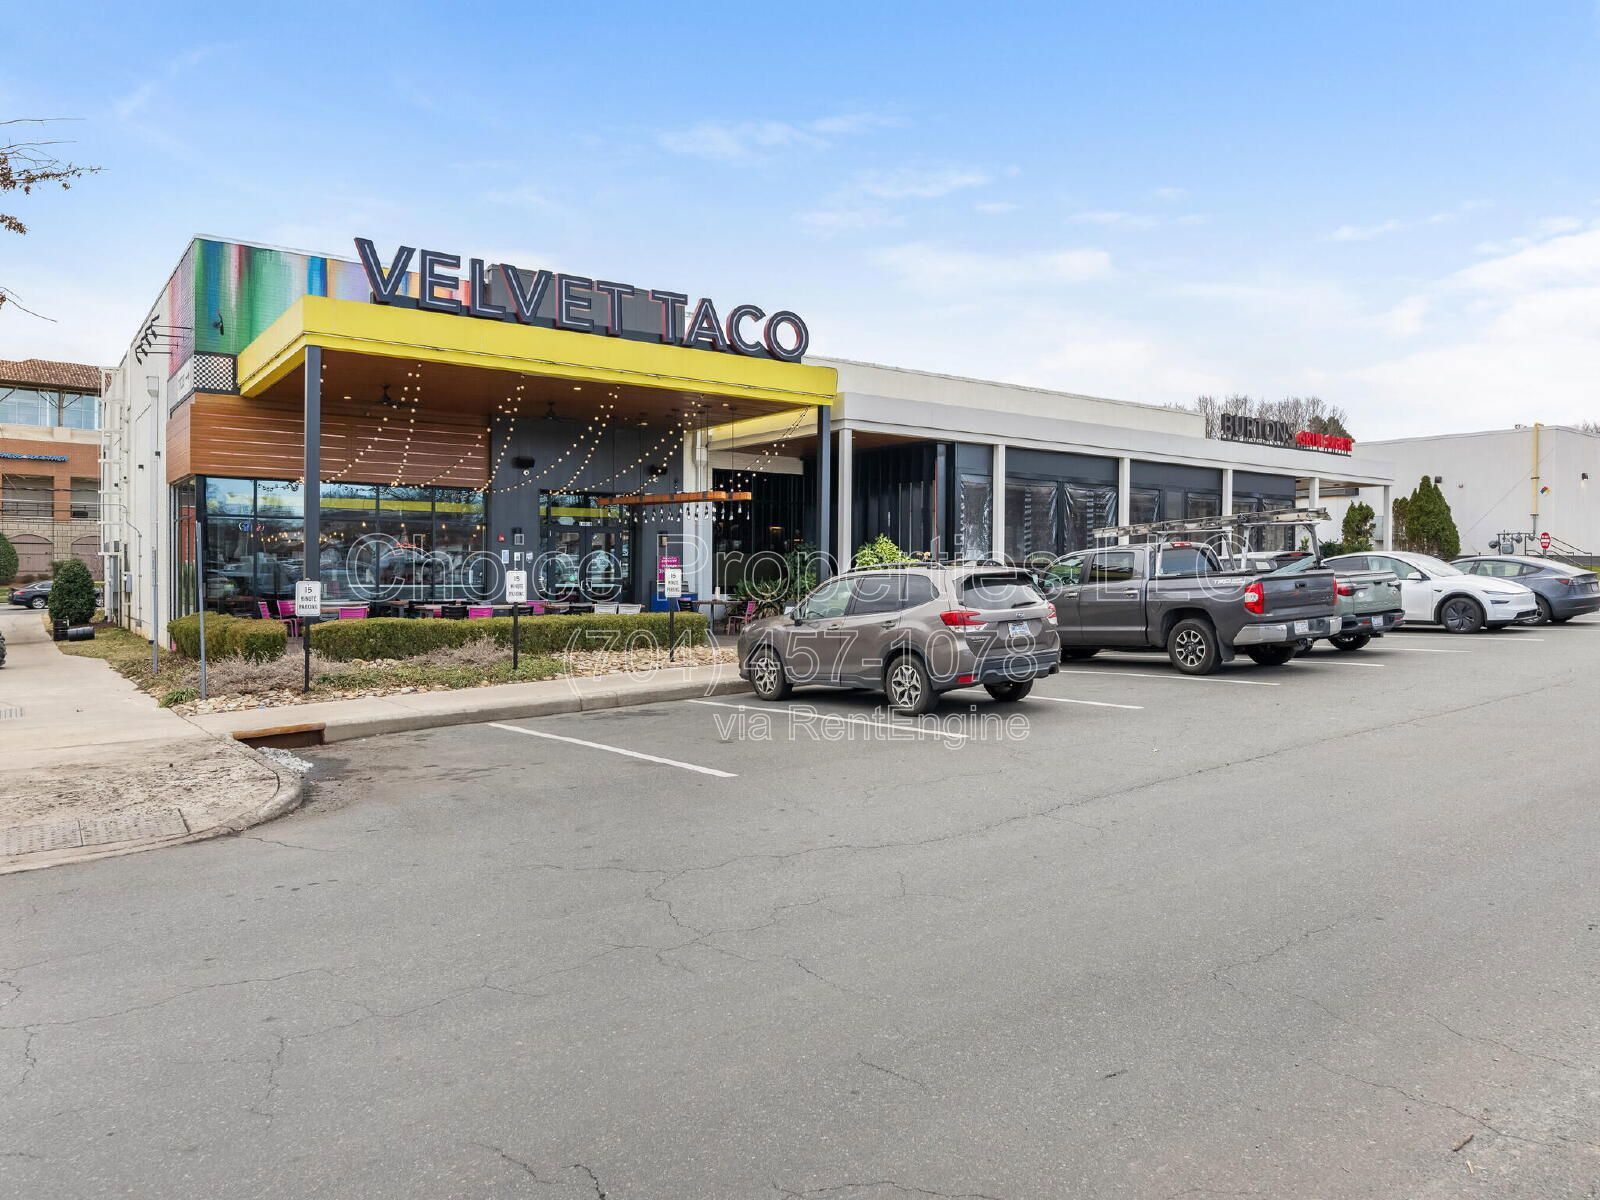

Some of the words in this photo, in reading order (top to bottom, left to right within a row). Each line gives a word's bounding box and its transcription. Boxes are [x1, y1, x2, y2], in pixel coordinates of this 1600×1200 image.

[354, 237, 634, 336] VELVET
[648, 289, 810, 363] TACO
[304, 586, 313, 594] 15
